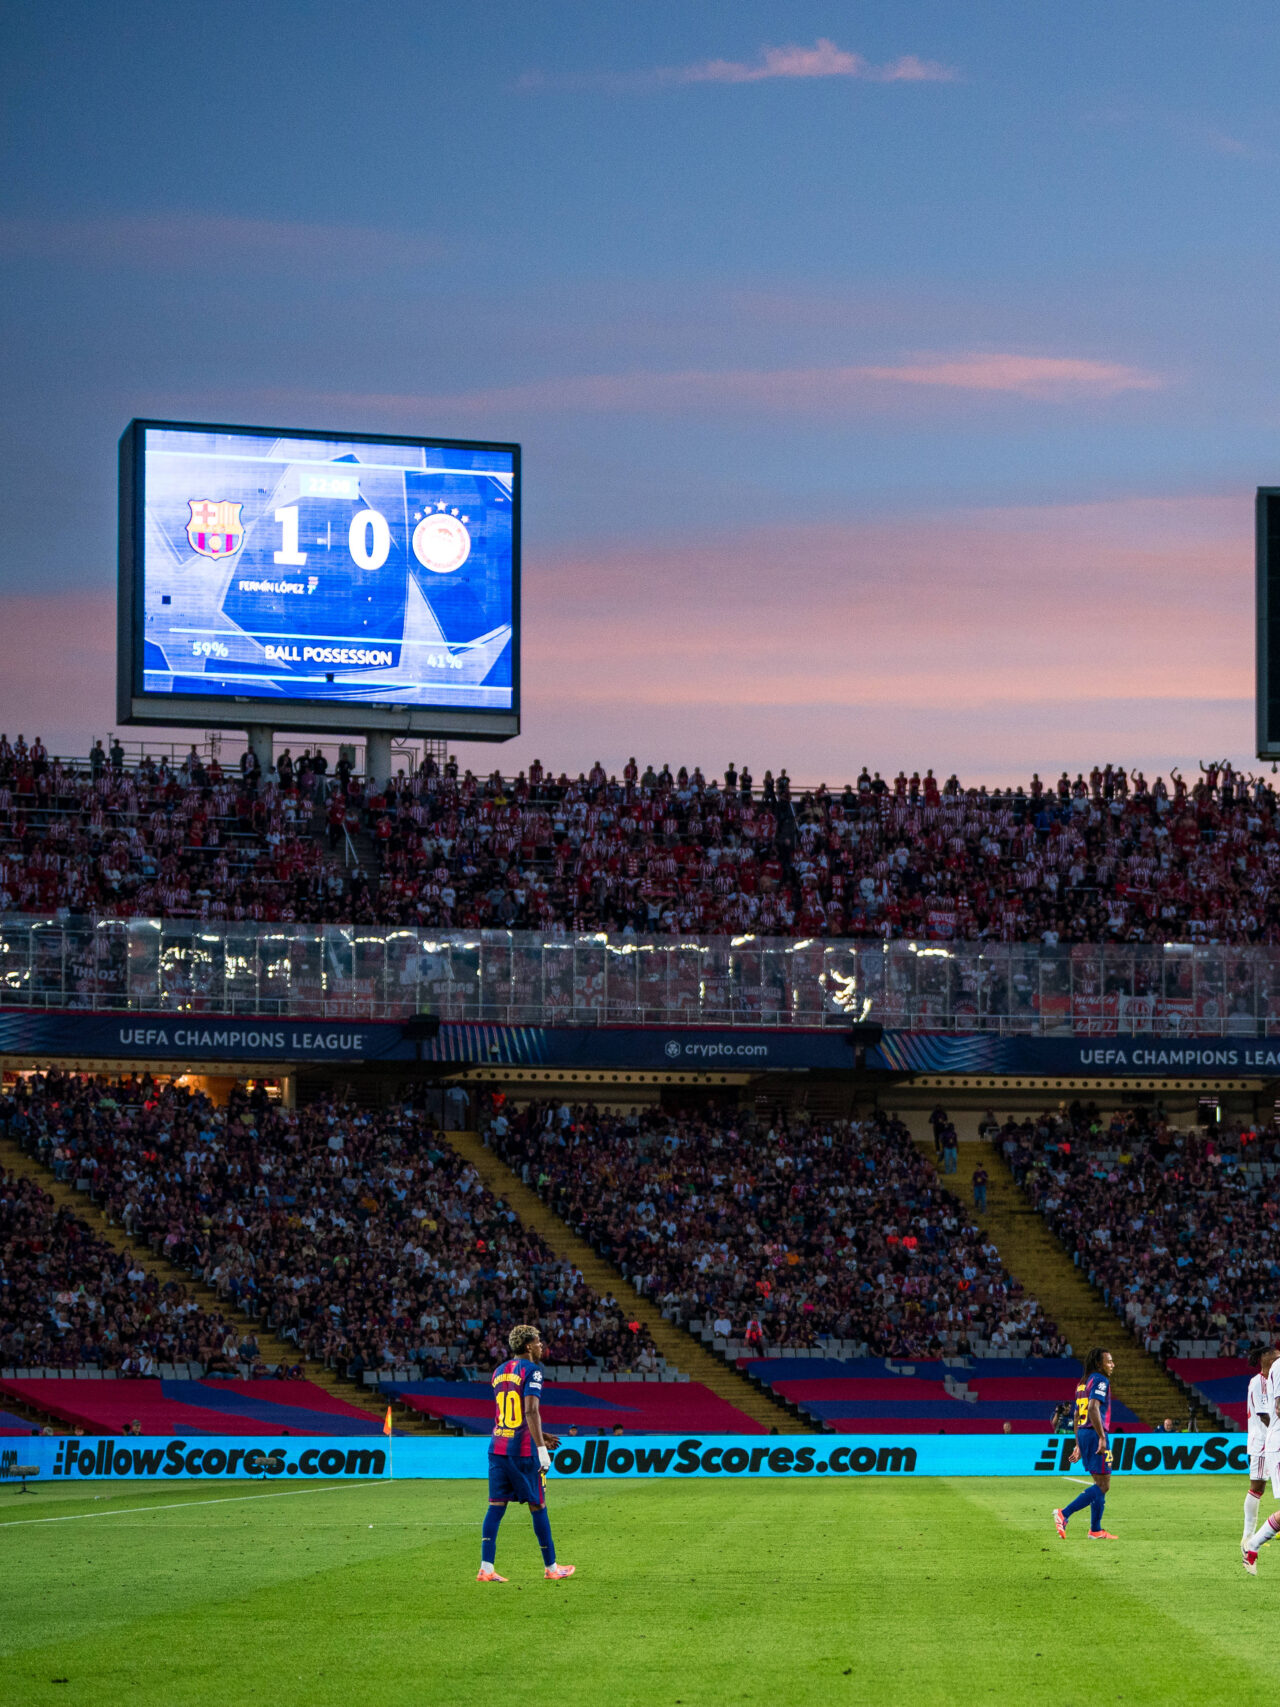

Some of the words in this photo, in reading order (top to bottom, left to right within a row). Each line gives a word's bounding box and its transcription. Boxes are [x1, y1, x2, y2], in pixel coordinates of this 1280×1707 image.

[273, 505, 308, 567] 1
[348, 509, 391, 571] 0
[239, 580, 275, 593] FERMÍN
[276, 580, 304, 595] LÓPEZ
[192, 641, 229, 658] 59%
[265, 644, 300, 662] BALL
[303, 647, 392, 666] POSSESSION
[427, 653, 463, 670] 41%
[119, 1028, 169, 1046] UEFA
[174, 1030, 285, 1048] CHAMPIONS
[292, 1033, 363, 1050] LEAGUE
[685, 1041, 768, 1057] crypto.com
[1080, 1049, 1127, 1065] UEFA
[1132, 1049, 1239, 1065] CHAMPIONS
[495, 1390, 523, 1429] 10
[64, 1439, 386, 1475] FollowScores.com
[549, 1439, 917, 1475] ollowScores.com
